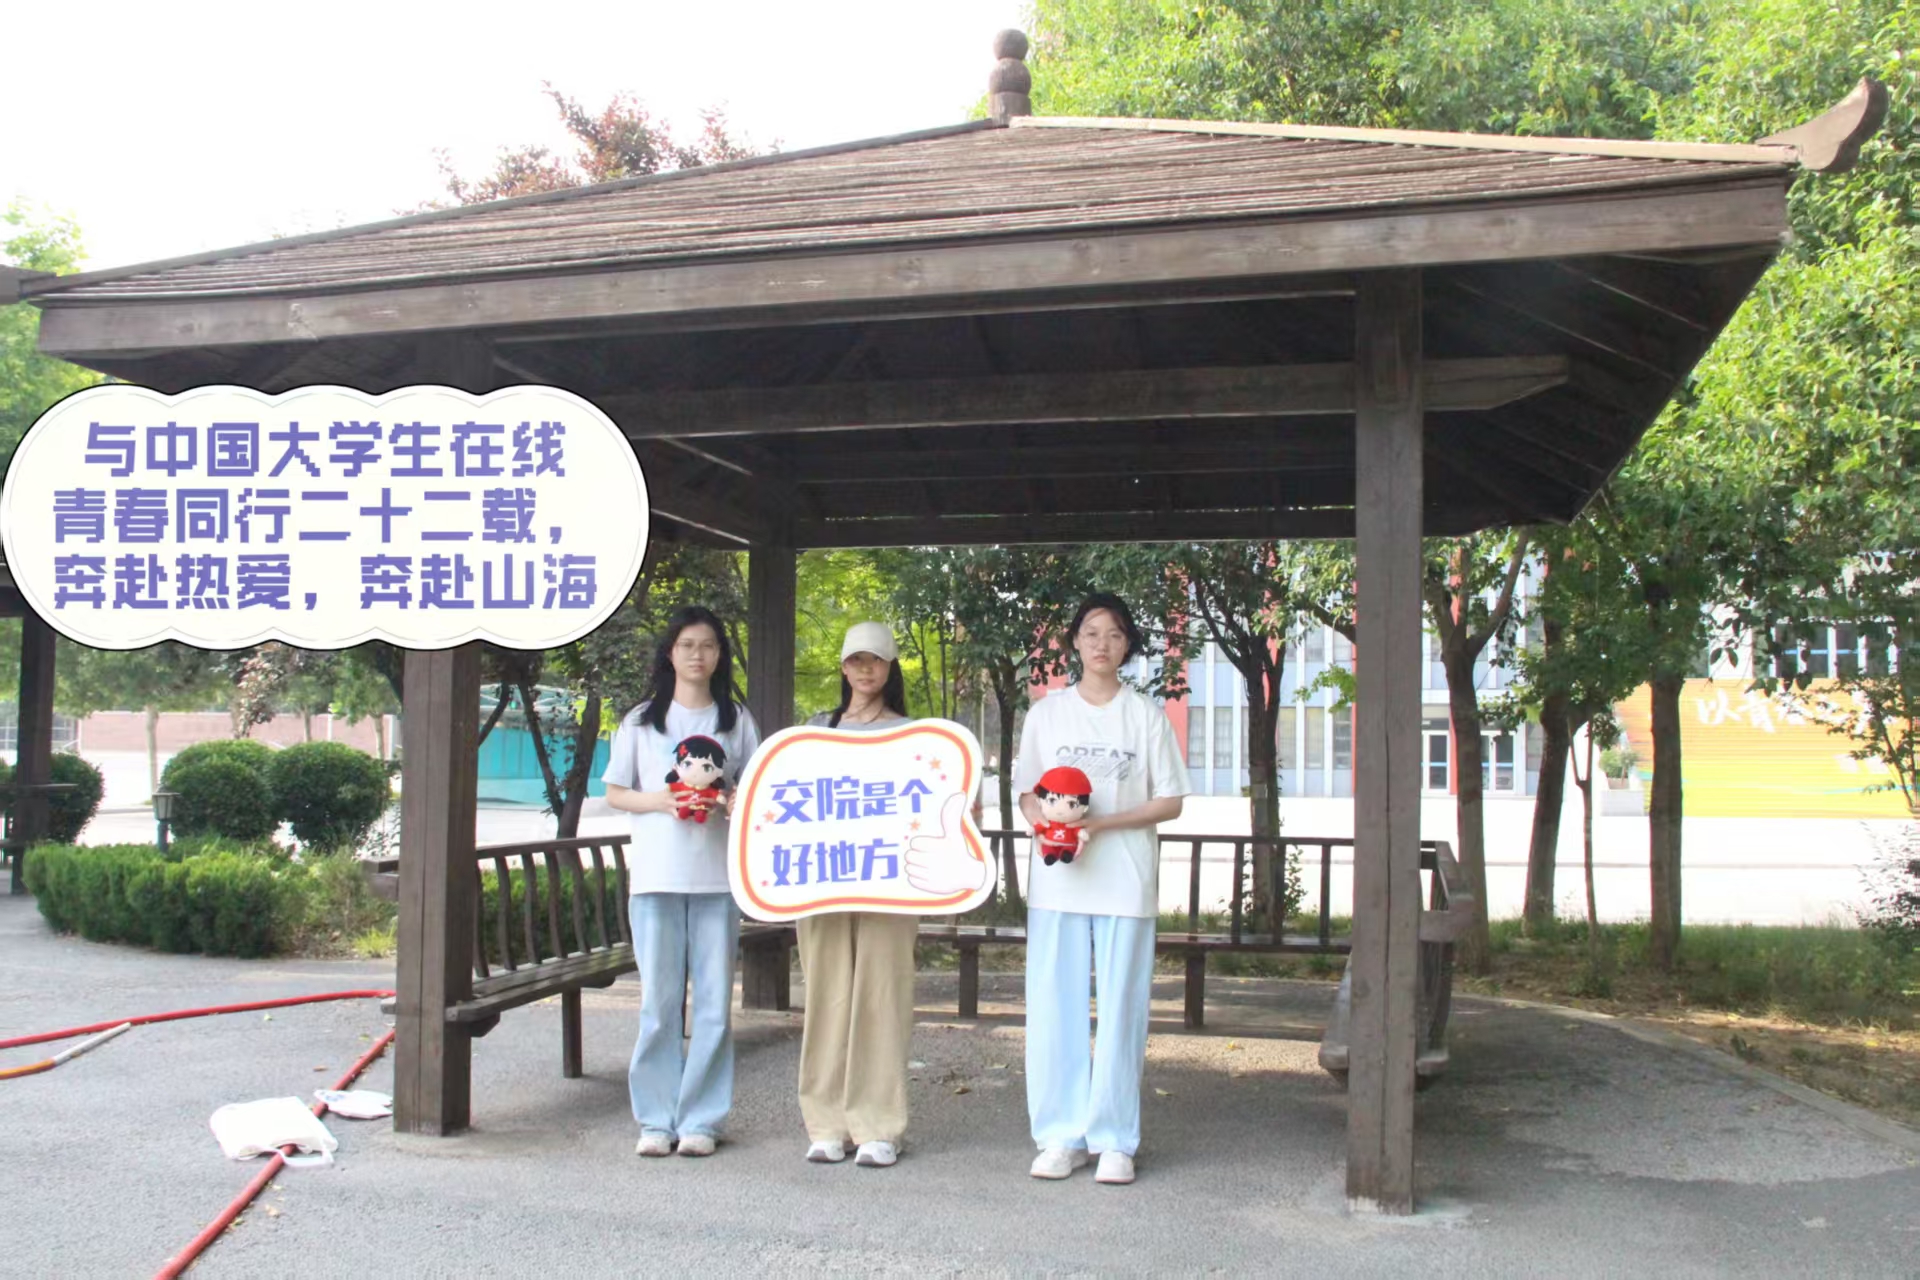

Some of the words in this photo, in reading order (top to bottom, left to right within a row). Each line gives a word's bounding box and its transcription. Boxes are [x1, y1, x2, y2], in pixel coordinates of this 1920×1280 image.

[771, 776, 933, 824] 交院是个
[772, 838, 899, 886] 好地方
